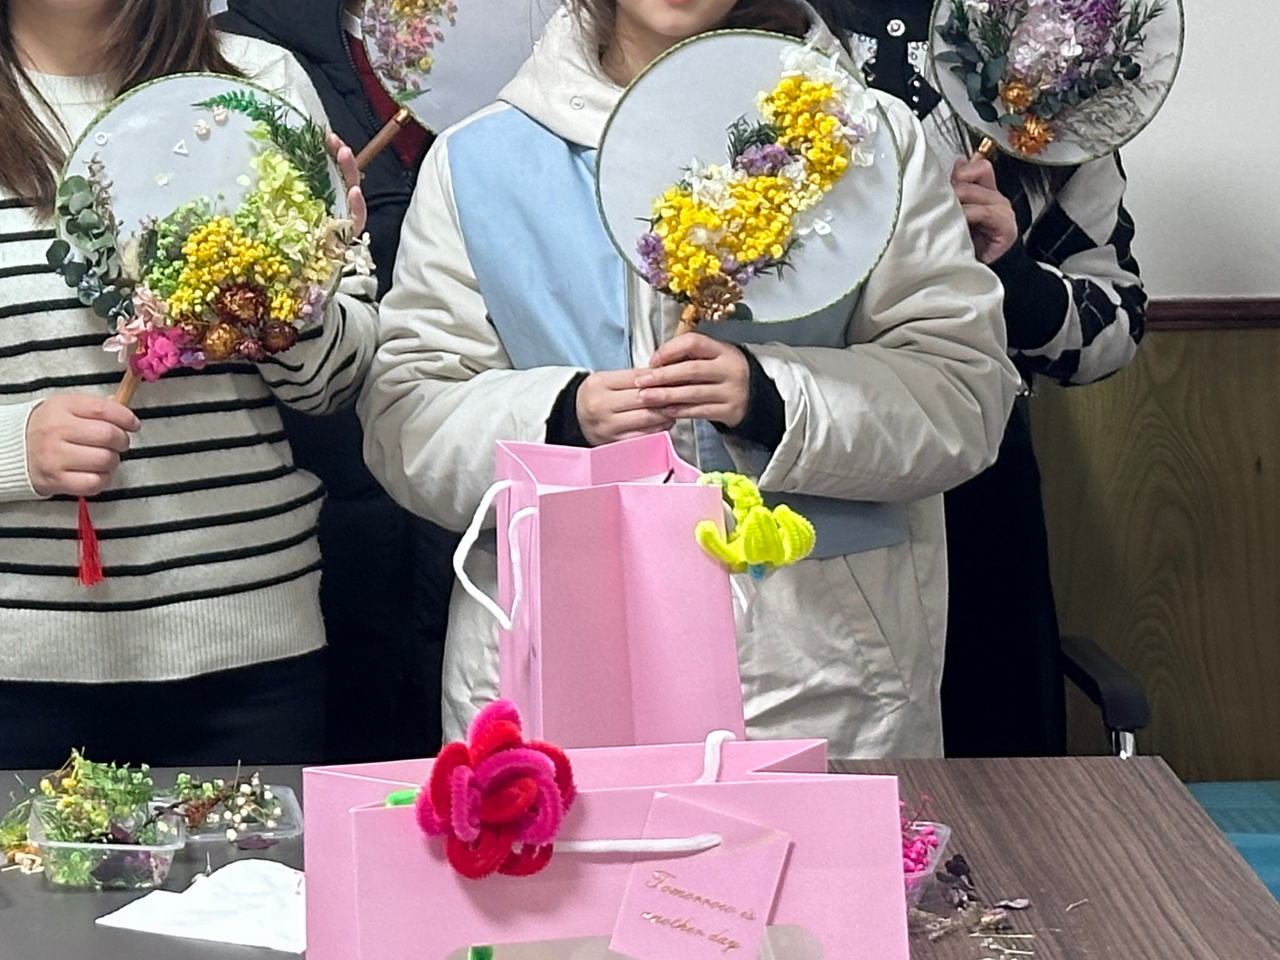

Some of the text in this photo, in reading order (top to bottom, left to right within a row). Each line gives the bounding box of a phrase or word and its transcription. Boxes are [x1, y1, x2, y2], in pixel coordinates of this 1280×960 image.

[645, 870, 756, 921] Tomorrow is
[641, 911, 740, 953] another day
